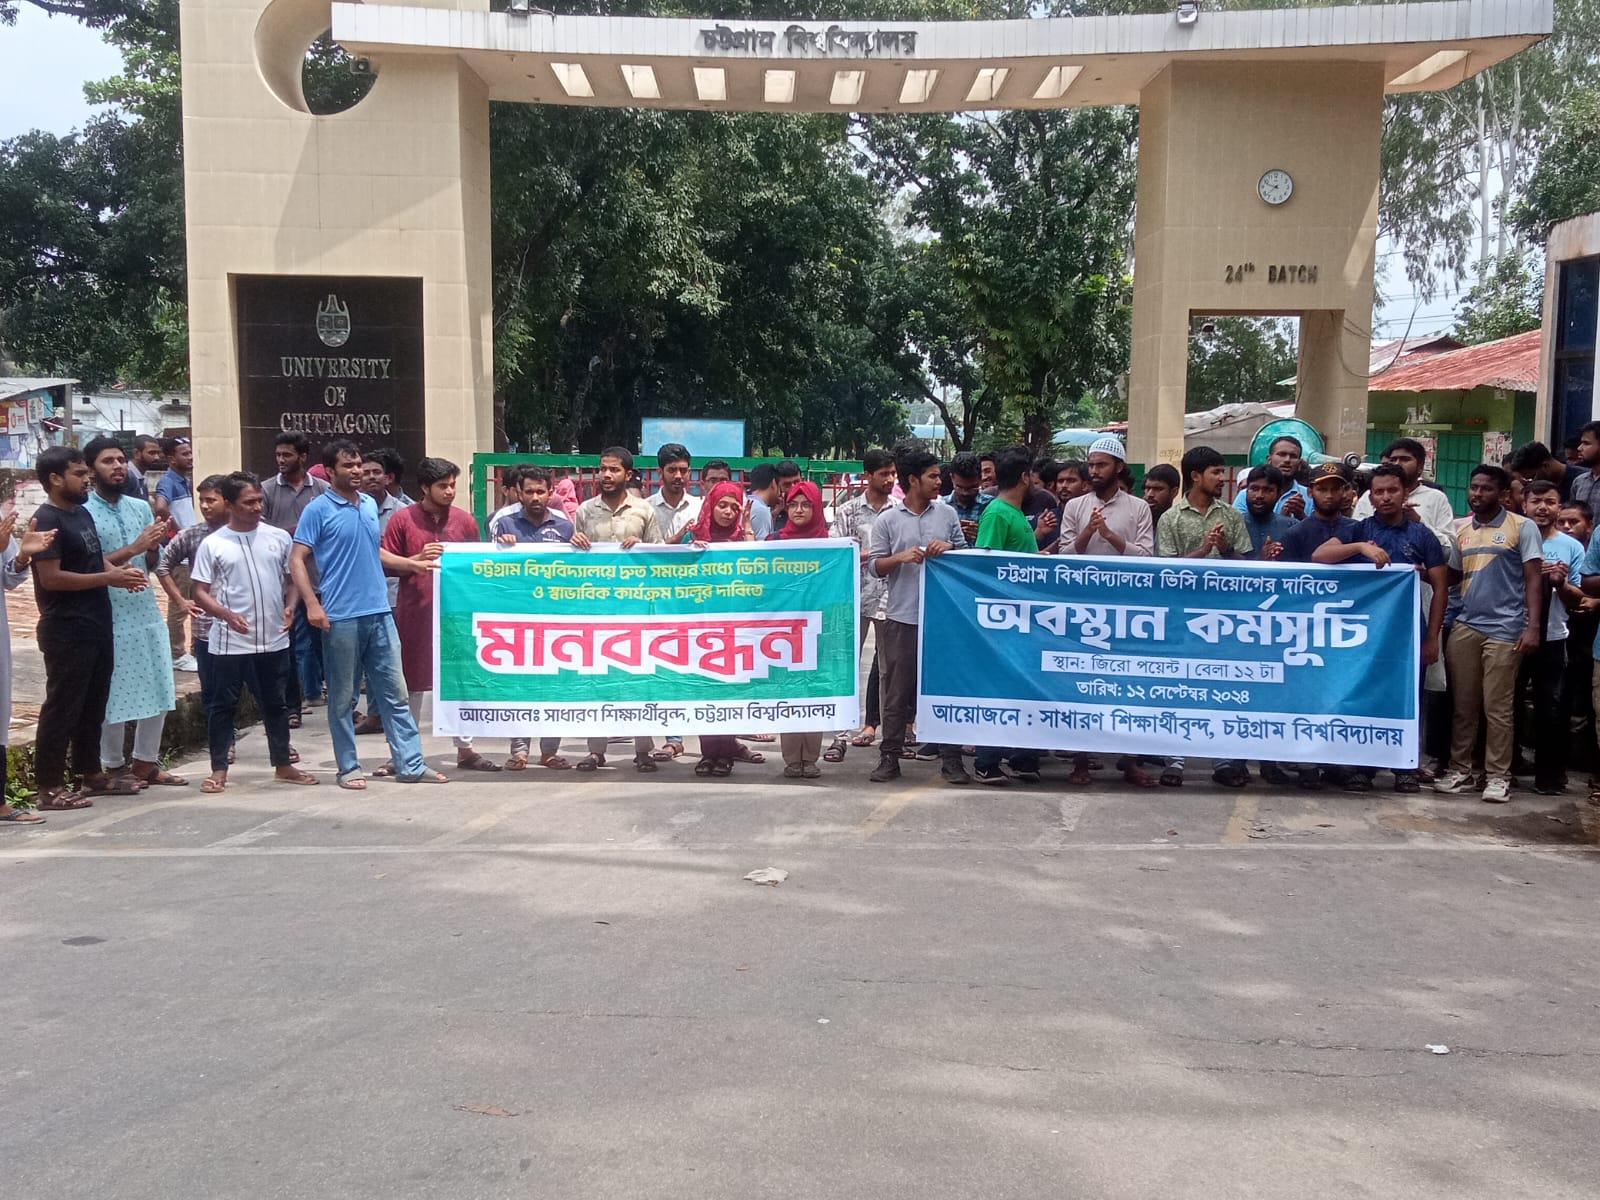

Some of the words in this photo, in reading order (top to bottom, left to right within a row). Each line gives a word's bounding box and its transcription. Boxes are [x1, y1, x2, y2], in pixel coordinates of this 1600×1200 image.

[1225, 262, 1255, 283] 24th
[1268, 265, 1318, 283] BATCH
[281, 356, 391, 379] UNIVERSITY
[324, 386, 347, 406] OF
[280, 413, 391, 435] CHITTAGONG
[472, 560, 521, 578] চট্টগ্রাম
[524, 558, 616, 580] বিশ্ববিদ্যালয়ে
[620, 564, 647, 579] দ্রুত
[650, 563, 698, 579] সময়ের
[701, 562, 733, 577] মধ্যে
[736, 557, 769, 575] ভিসি
[772, 556, 820, 575] নিয়োগ
[996, 562, 1049, 584] চট্টগ্রাম
[1054, 564, 1154, 589] বিশ্ববিদ্যালয়ে
[1160, 569, 1198, 590] ভিসি
[1202, 570, 1277, 595] নিয়োগের
[1282, 574, 1339, 595] দাবিতে
[532, 586, 544, 599] ও
[548, 582, 610, 600] স্বাভাবিক
[614, 582, 671, 601] কার্যক্রম
[675, 583, 712, 602] চালুর
[716, 580, 764, 597] দাবিতে
[975, 597, 1169, 651] অবস্থান
[1184, 594, 1369, 667] কর্মসূচি
[477, 618, 808, 676] মানববন্ধন
[1052, 654, 1085, 671] স্থান:
[1091, 655, 1130, 674] জিরো
[1137, 661, 1180, 675] পয়েন্ট
[1195, 663, 1229, 679] বেলা
[1234, 666, 1254, 681] ১২
[1260, 663, 1275, 680] টা
[1076, 678, 1122, 697] তারিখ:
[1127, 686, 1146, 700] ১২
[1149, 683, 1207, 702] সেপ্টেম্বর
[1211, 690, 1250, 705] ২০২৪
[459, 707, 540, 724] আয়োজনেঃ
[544, 708, 599, 724] সাধারণ
[601, 703, 690, 727] শিক্ষার্থীবৃন্দ,
[695, 704, 743, 723] চট্টগ্রাম
[747, 701, 837, 722] বিশ্ববিদ্যালয়
[932, 704, 1021, 727] আয়োজনে
[1039, 708, 1104, 731] সাধারণ
[1110, 708, 1214, 741] শিক্ষার্থীবৃন্দ,
[1222, 714, 1285, 740] চট্টগ্রাম
[1292, 718, 1404, 747] বিশ্ববিদ্যালয়
